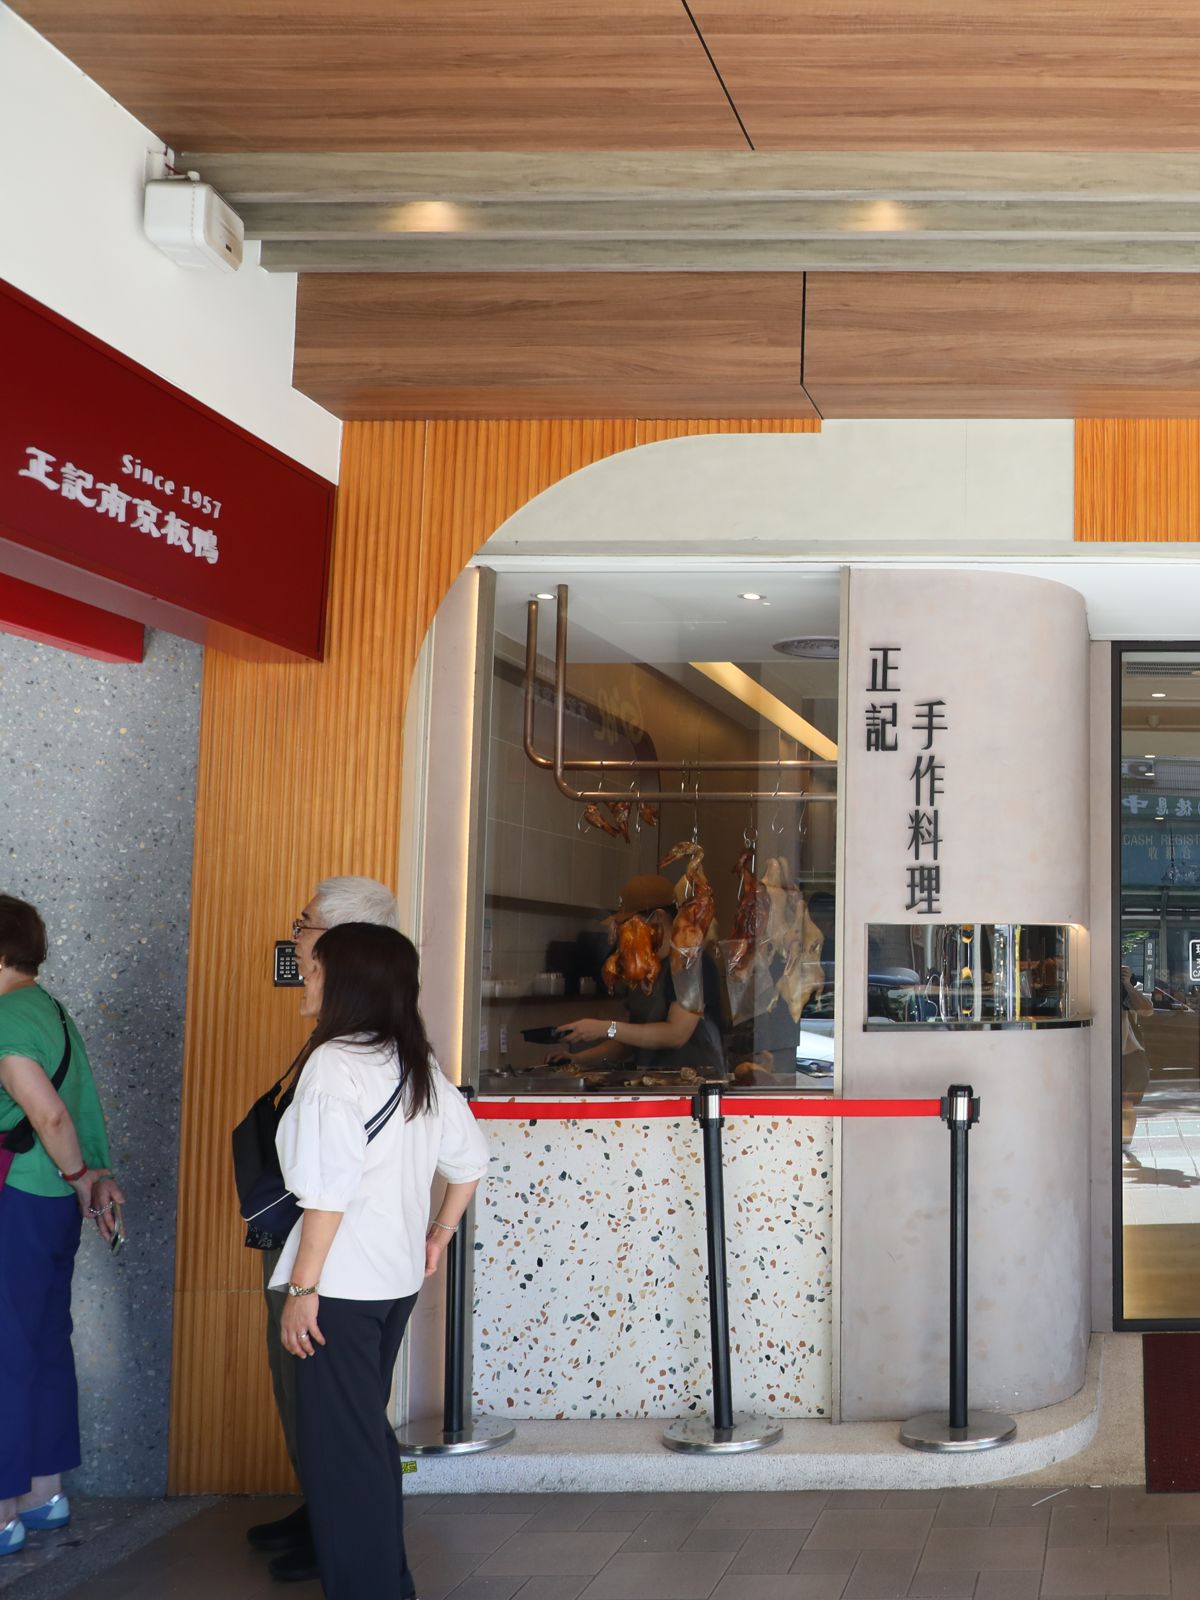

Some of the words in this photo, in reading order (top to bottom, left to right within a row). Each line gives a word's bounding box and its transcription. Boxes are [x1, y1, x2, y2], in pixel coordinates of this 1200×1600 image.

[18, 446, 220, 564] 正記南京板鴨
[121, 454, 175, 496] Since
[181, 485, 223, 519] 1957
[865, 647, 901, 751] 正記
[905, 700, 948, 914] 手作料理
[1123, 834, 1153, 846] CASH
